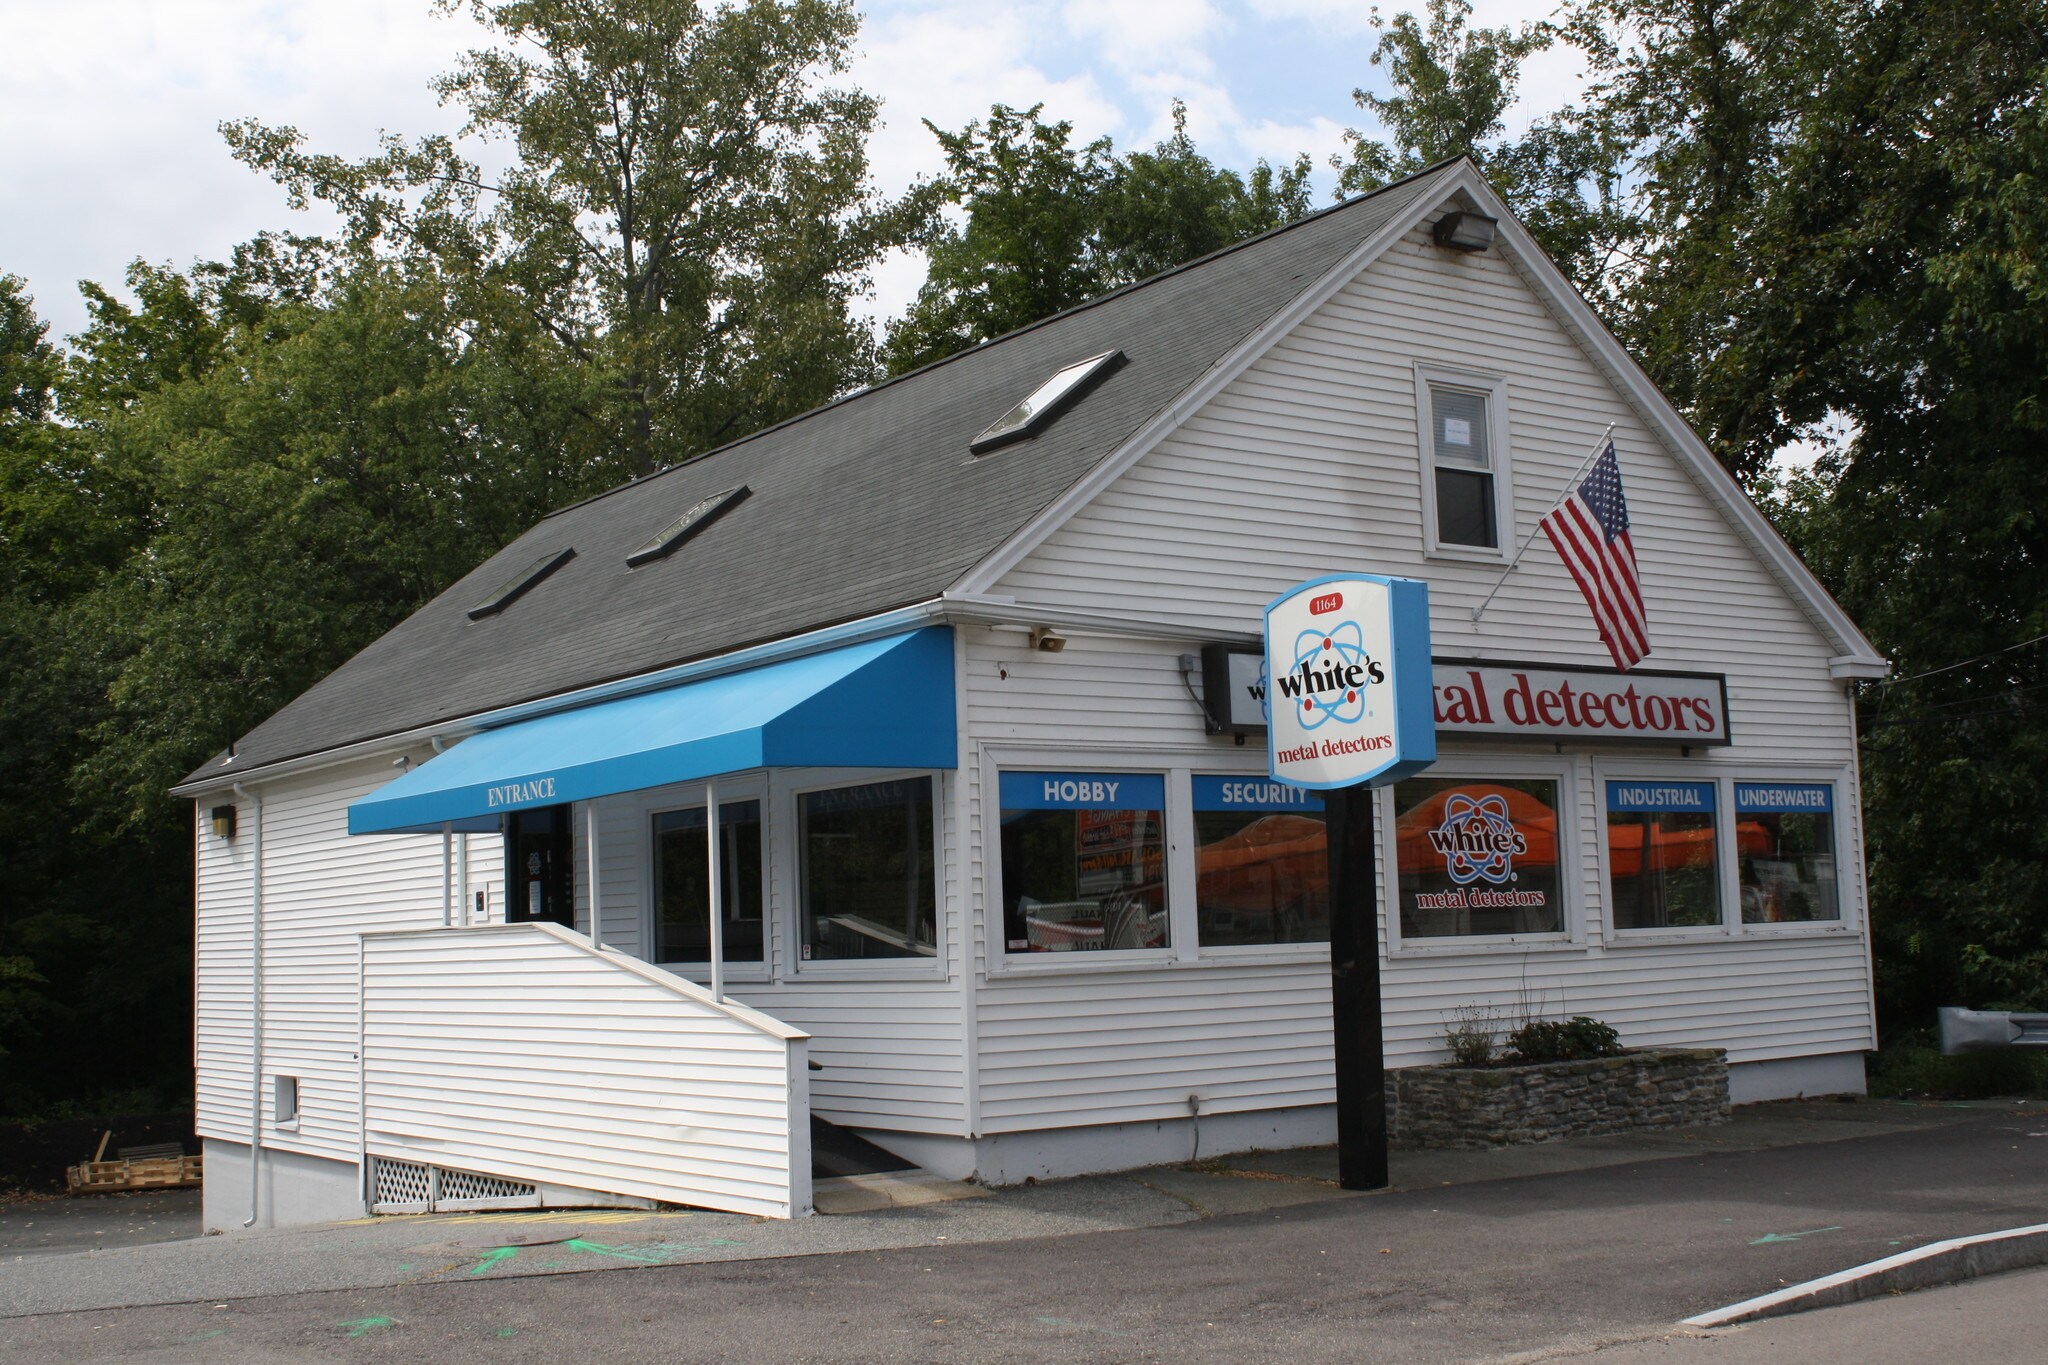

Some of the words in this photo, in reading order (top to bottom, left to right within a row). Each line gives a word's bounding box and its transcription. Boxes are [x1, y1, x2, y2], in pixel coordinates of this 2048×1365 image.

[1315, 597, 1337, 612] 1164
[1277, 655, 1385, 698] white's
[1432, 671, 1495, 724] tal
[1503, 672, 1717, 733] detectors
[1277, 741, 1319, 764] metal
[1321, 734, 1393, 757] detectors
[487, 777, 556, 807] ENTRANCE
[1043, 779, 1120, 803] HOBBY
[1222, 782, 1306, 804] SECURITY
[1618, 788, 1702, 806] INDUSTRIAL
[1738, 788, 1826, 808] UNDERWATER
[1428, 822, 1527, 854] white's
[1415, 887, 1468, 909] metal
[1469, 886, 1546, 907] detectors
